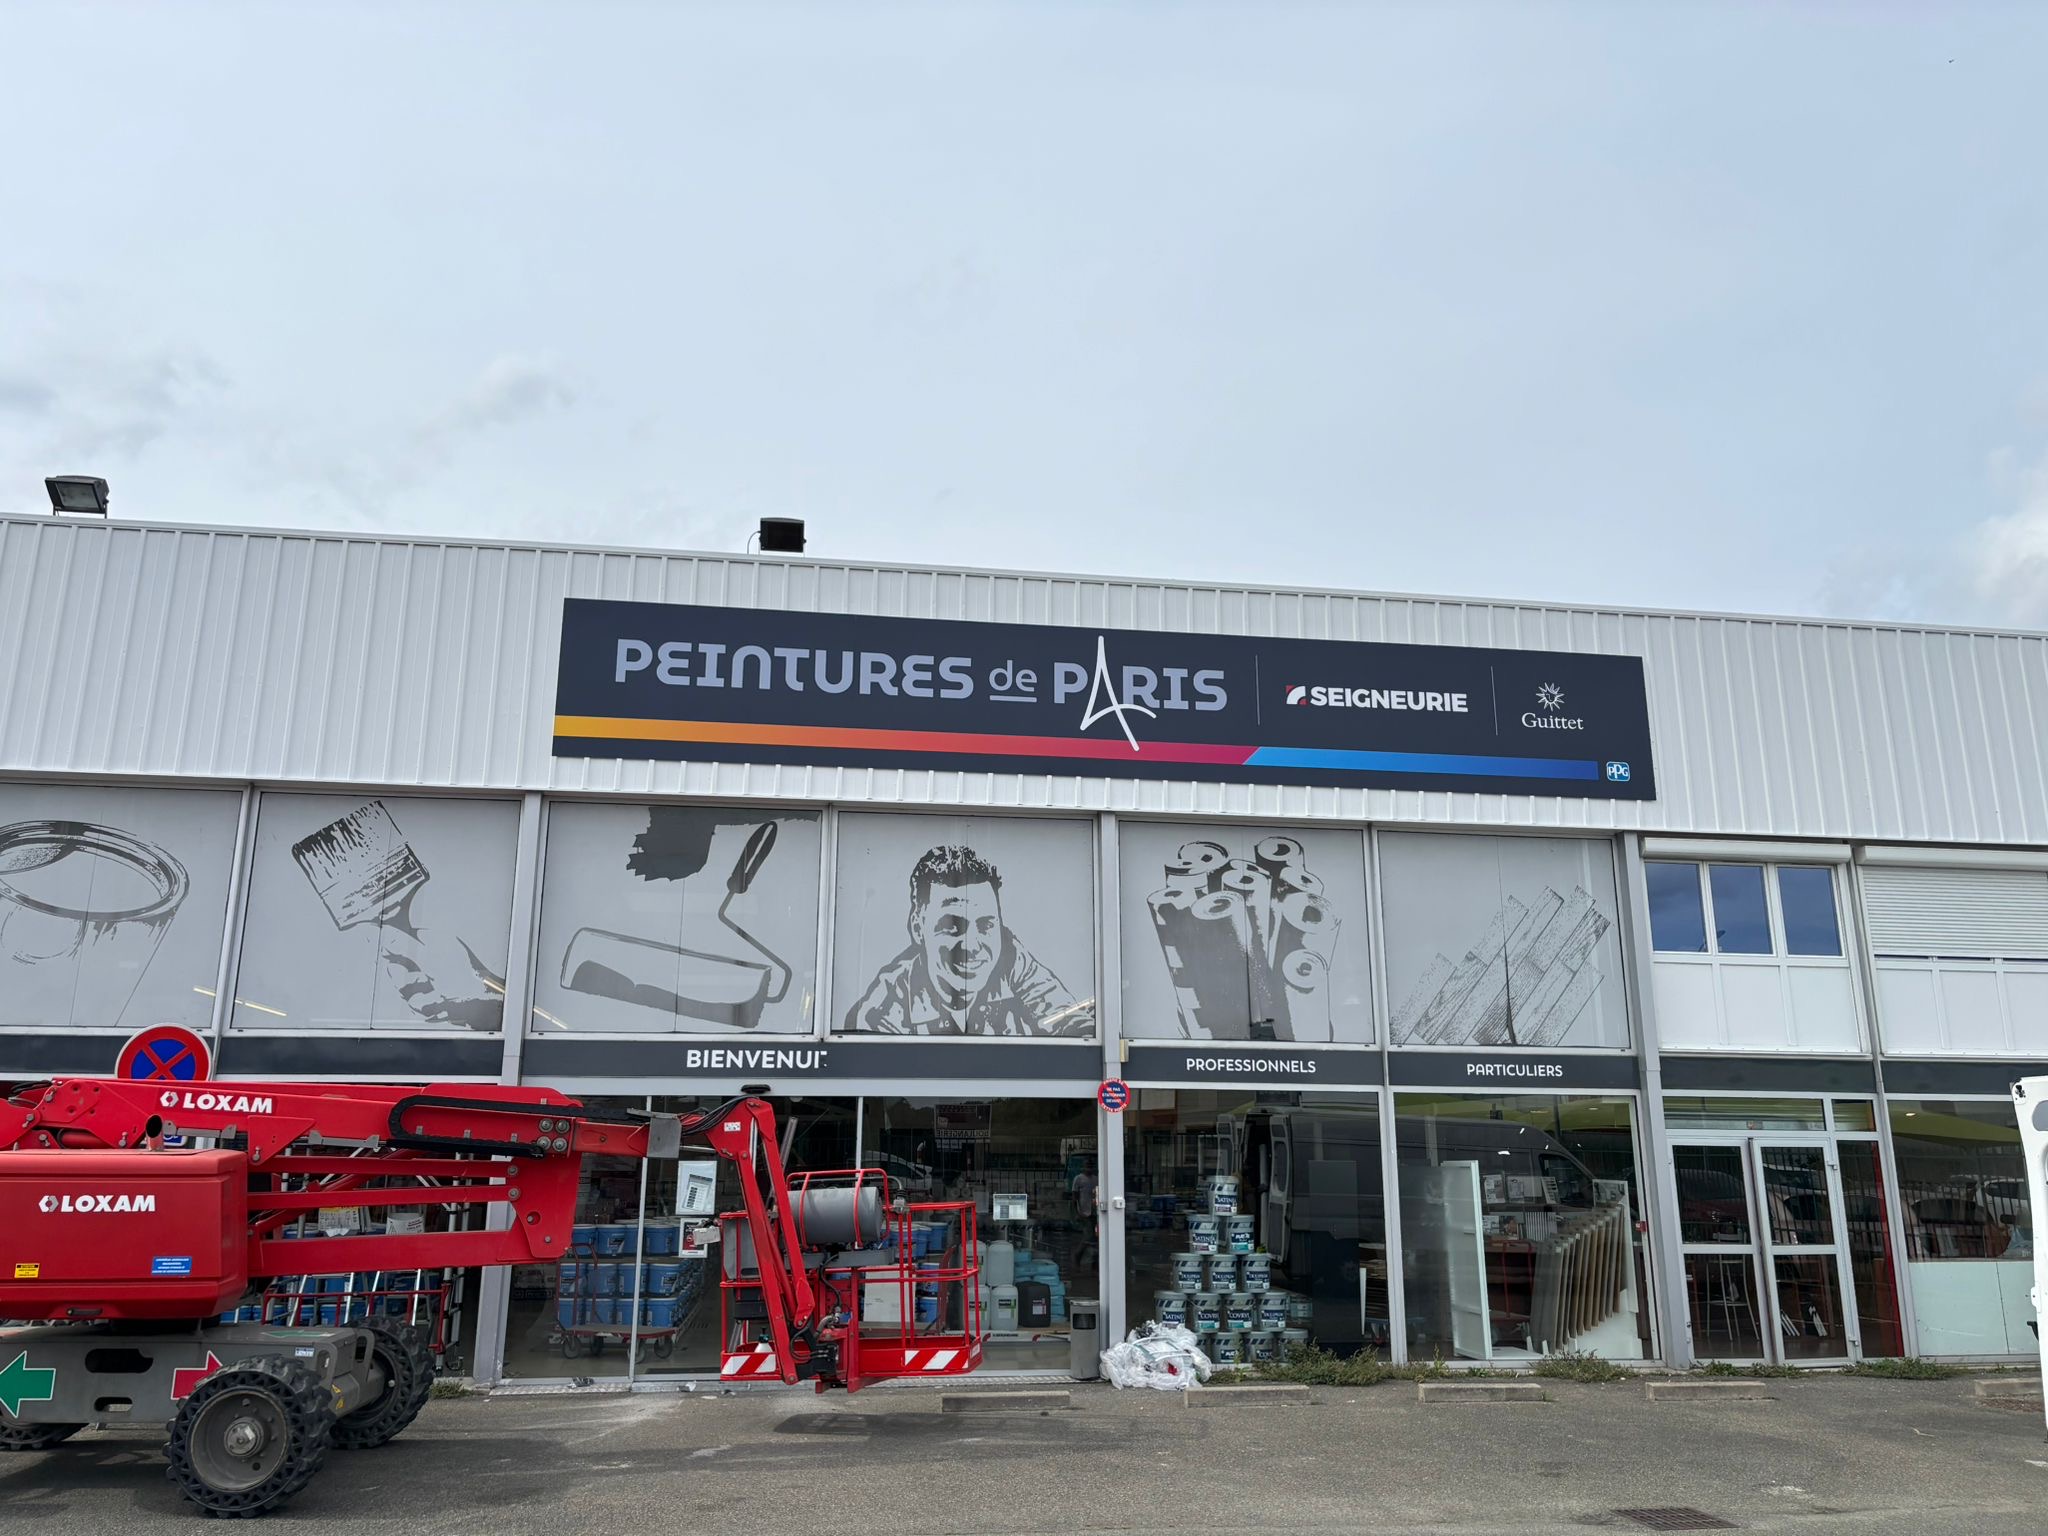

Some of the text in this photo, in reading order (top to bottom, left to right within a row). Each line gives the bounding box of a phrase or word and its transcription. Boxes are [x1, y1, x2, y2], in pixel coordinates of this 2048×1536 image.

[615, 635, 1228, 751] PEINTURES de PARIS
[1310, 686, 1468, 712] SEIGNEURIE
[1521, 712, 1584, 730] Guittet
[1608, 764, 1628, 779] PPG
[1186, 1058, 1317, 1073] PROFESSIONNELS
[1466, 1063, 1563, 1077] PARTICULIERS
[183, 1092, 273, 1114] LOXAM
[61, 1195, 155, 1213] LOXAM
